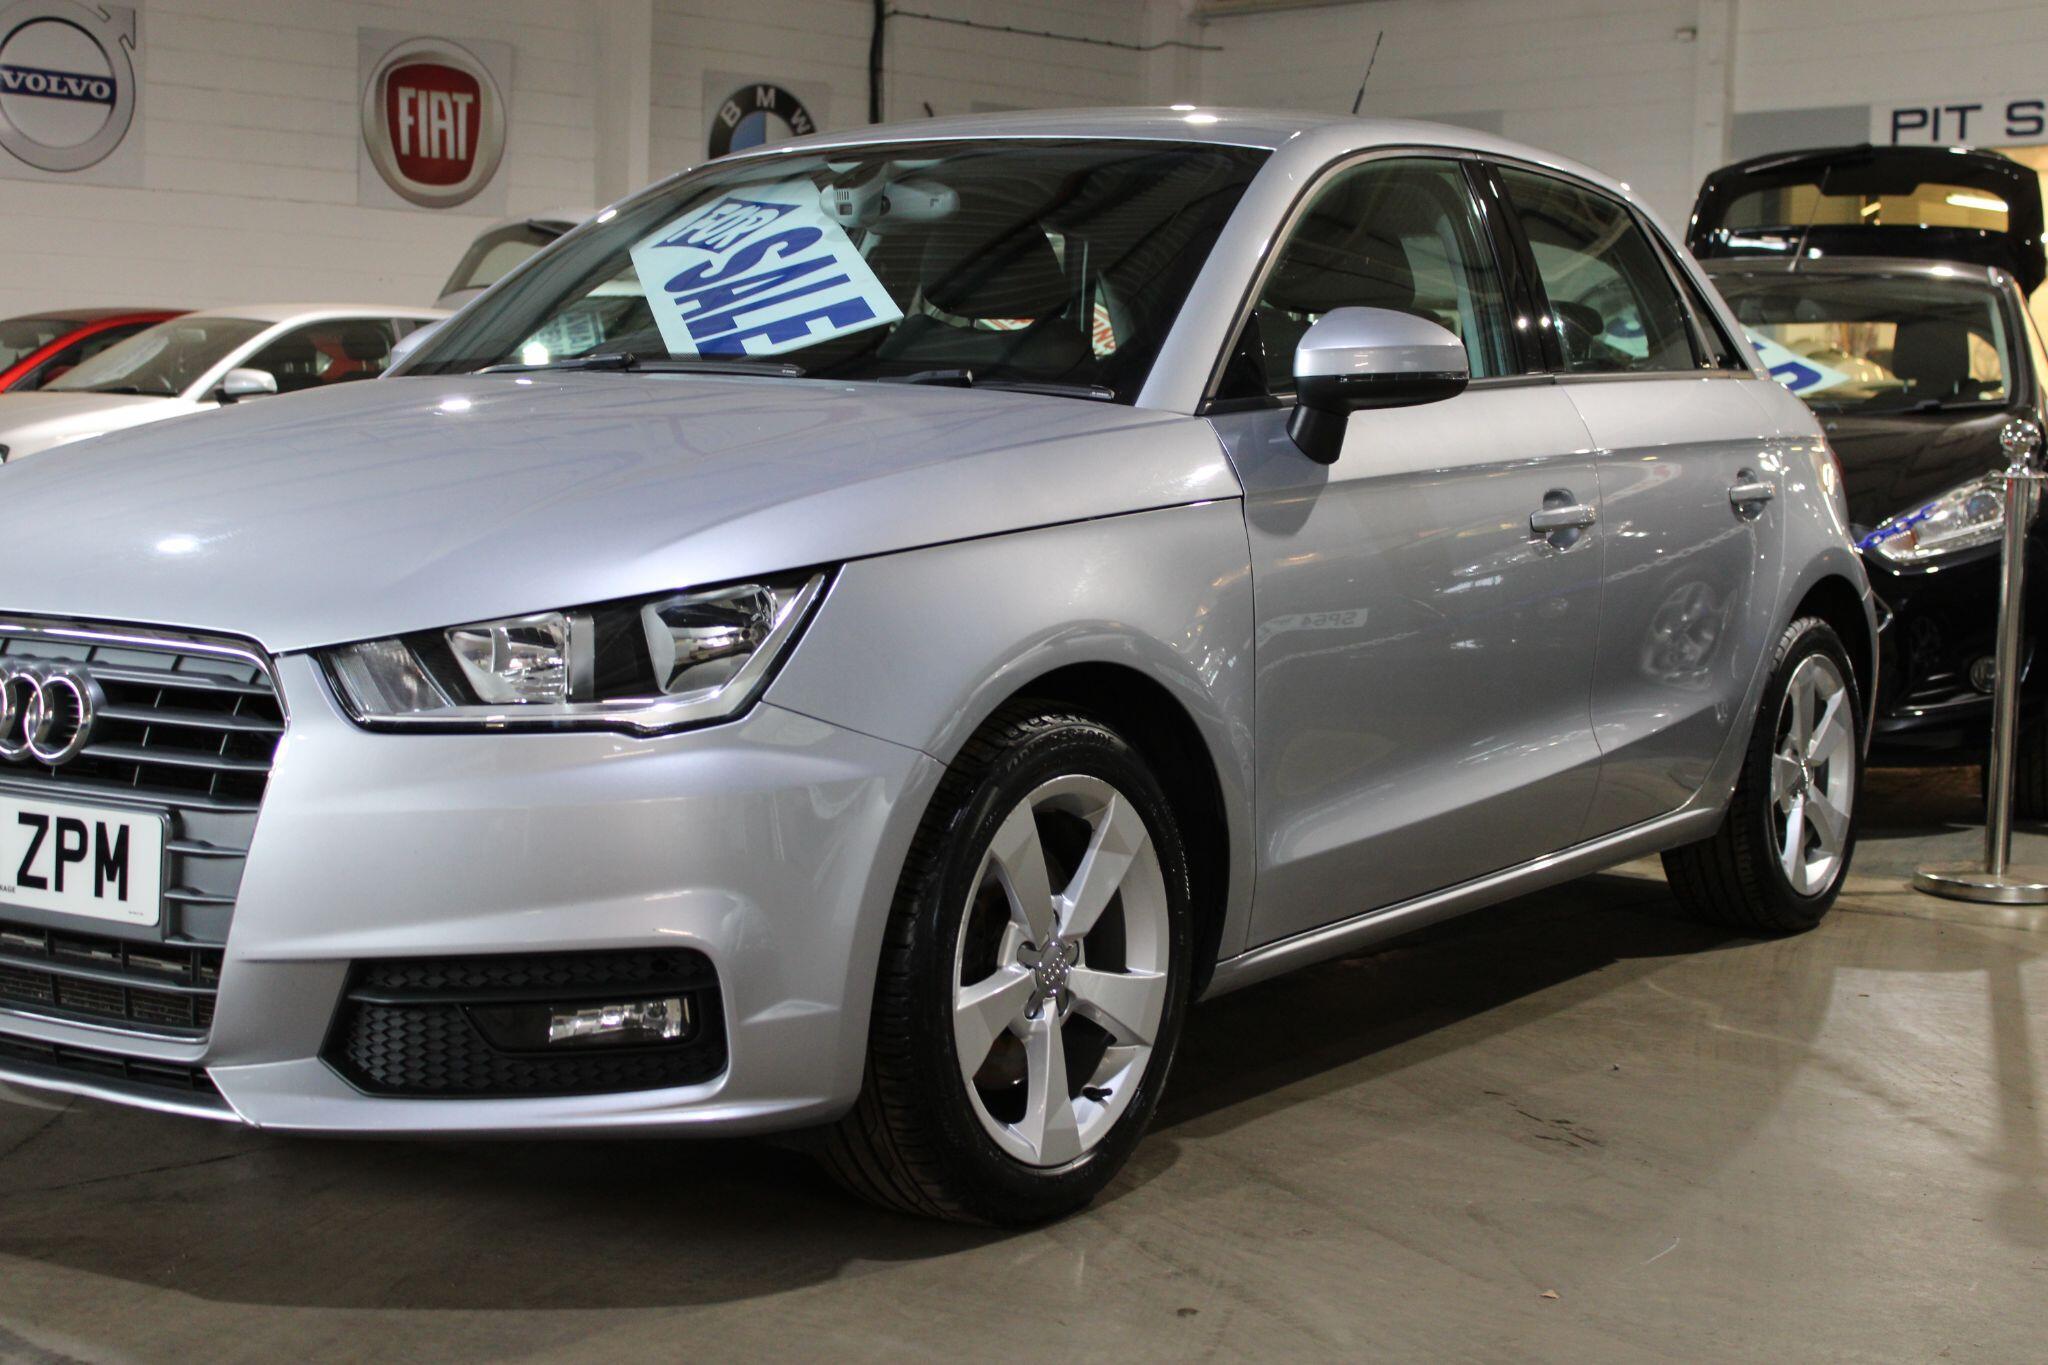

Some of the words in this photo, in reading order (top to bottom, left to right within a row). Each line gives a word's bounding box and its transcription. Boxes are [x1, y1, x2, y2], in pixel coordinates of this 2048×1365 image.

[1, 69, 111, 99] VOLVO
[398, 86, 473, 160] FIAT
[720, 86, 811, 134] BMW
[1892, 104, 1982, 144] PIT
[666, 203, 780, 249] FOR
[663, 226, 877, 356] SALE
[16, 811, 130, 902] ZPM
